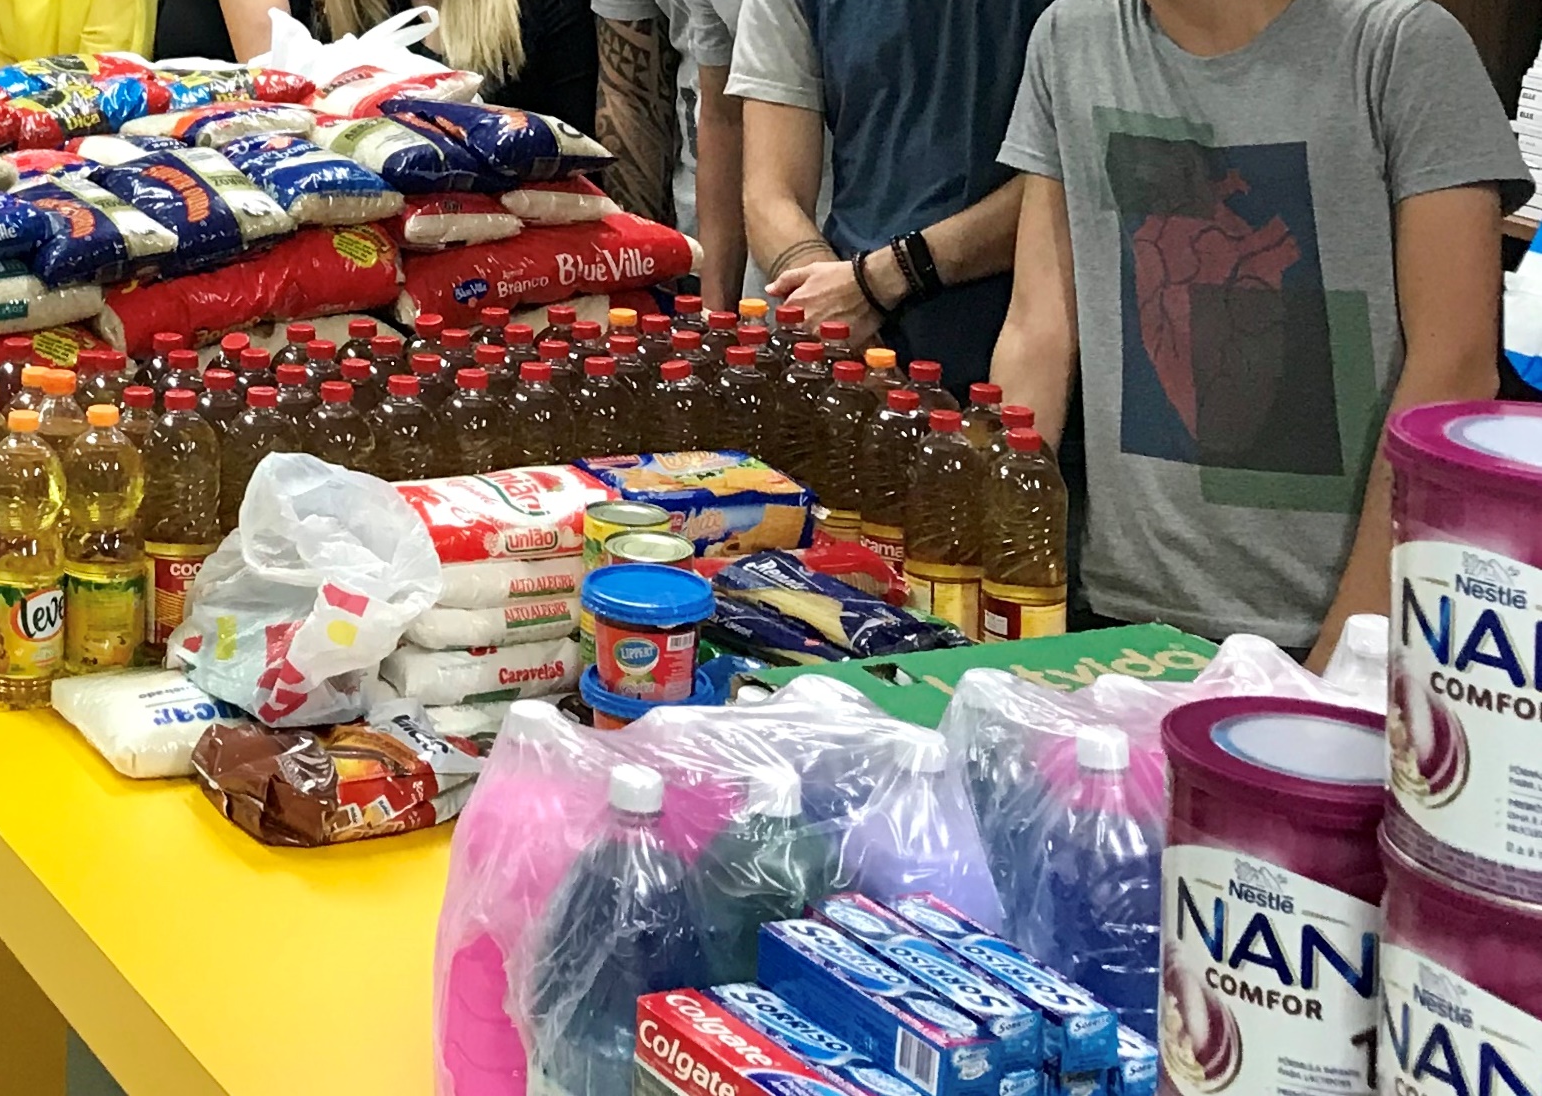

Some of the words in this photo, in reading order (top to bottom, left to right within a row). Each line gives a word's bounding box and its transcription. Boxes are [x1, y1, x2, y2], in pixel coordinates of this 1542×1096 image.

[496, 275, 549, 299] Branco
[508, 527, 554, 549] união
[1401, 576, 1542, 693] NA
[1430, 670, 1542, 723] COMFO
[1176, 875, 1379, 999] NAN
[1205, 966, 1324, 1021] COMFOR
[639, 1019, 736, 1096] Colgate
[665, 993, 774, 1068] Colgate
